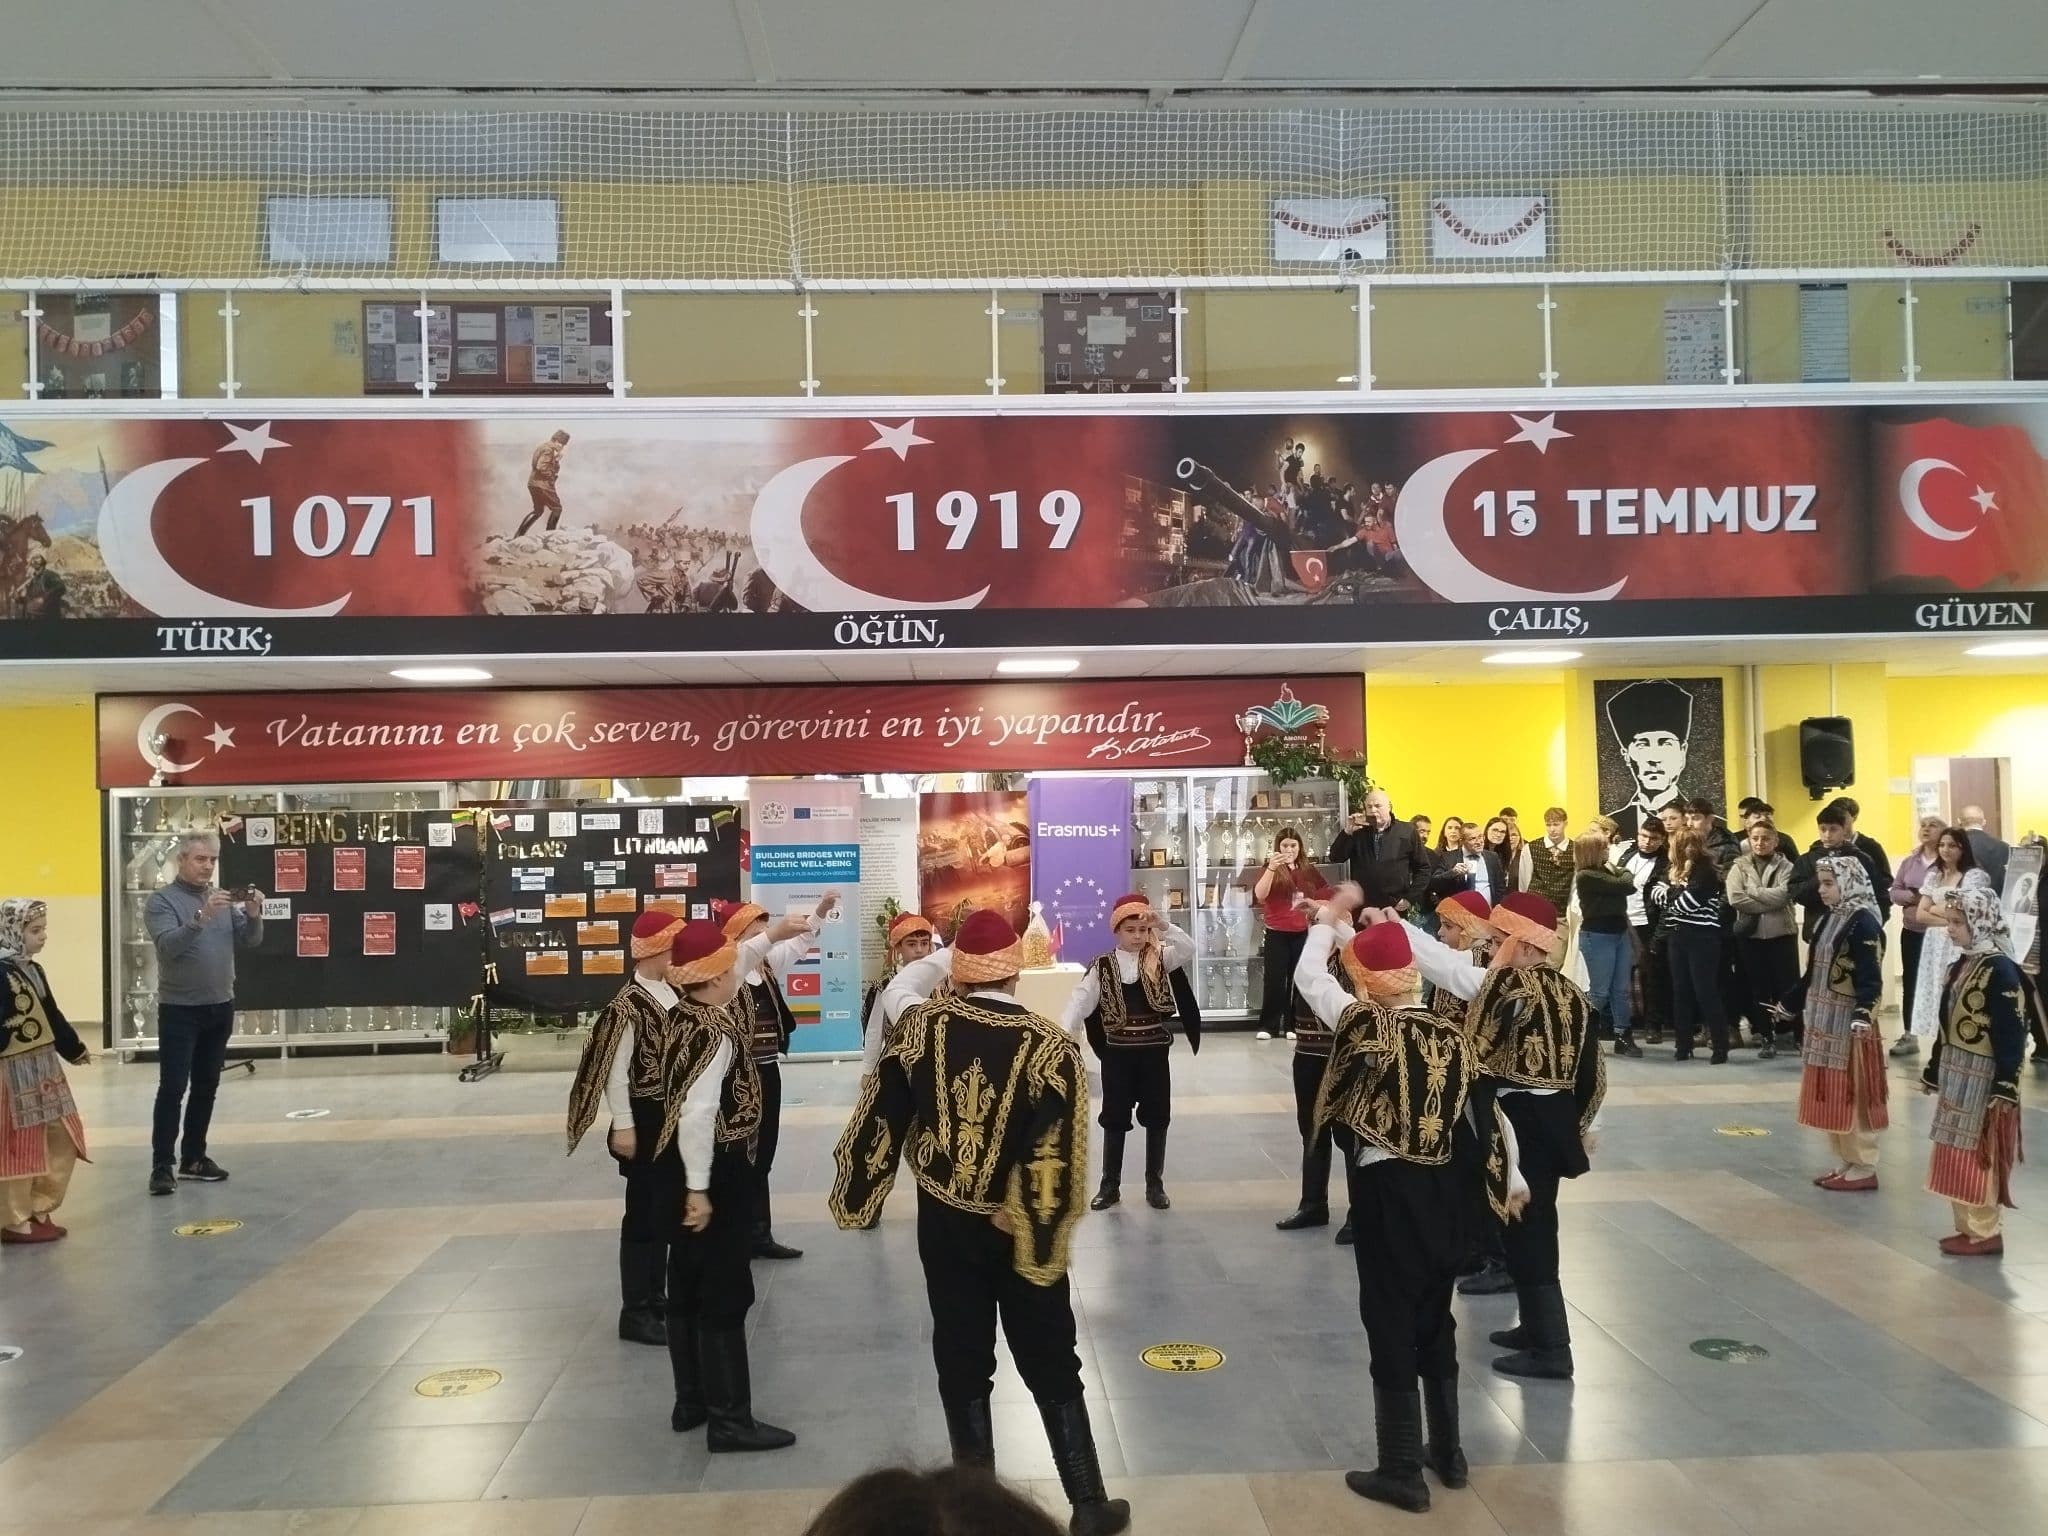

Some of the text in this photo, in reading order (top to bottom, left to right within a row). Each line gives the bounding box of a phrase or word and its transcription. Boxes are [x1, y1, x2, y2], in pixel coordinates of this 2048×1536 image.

[241, 495, 433, 557] 1071
[885, 490, 1081, 551] 1919
[1474, 485, 1817, 537] 15 TEMMUZ
[1488, 606, 1589, 635] ÇALIŞ,
[1915, 597, 2035, 629] GÜVEN
[156, 621, 272, 656] TÜRK;
[834, 613, 945, 647] ÖĞÜN,
[266, 701, 1166, 752] Vatanını en çok seven, görevini en iyi yapandır.
[275, 811, 421, 845] BEING WELL
[1037, 822, 1121, 837] Erasmus+
[498, 840, 568, 860] POLAND
[613, 836, 709, 856] LITHUANIA
[755, 850, 857, 860] BUILDING BRIDGES WITH
[760, 860, 852, 869] HOLISTIC WELL-BEING
[265, 909, 283, 917] PLUS
